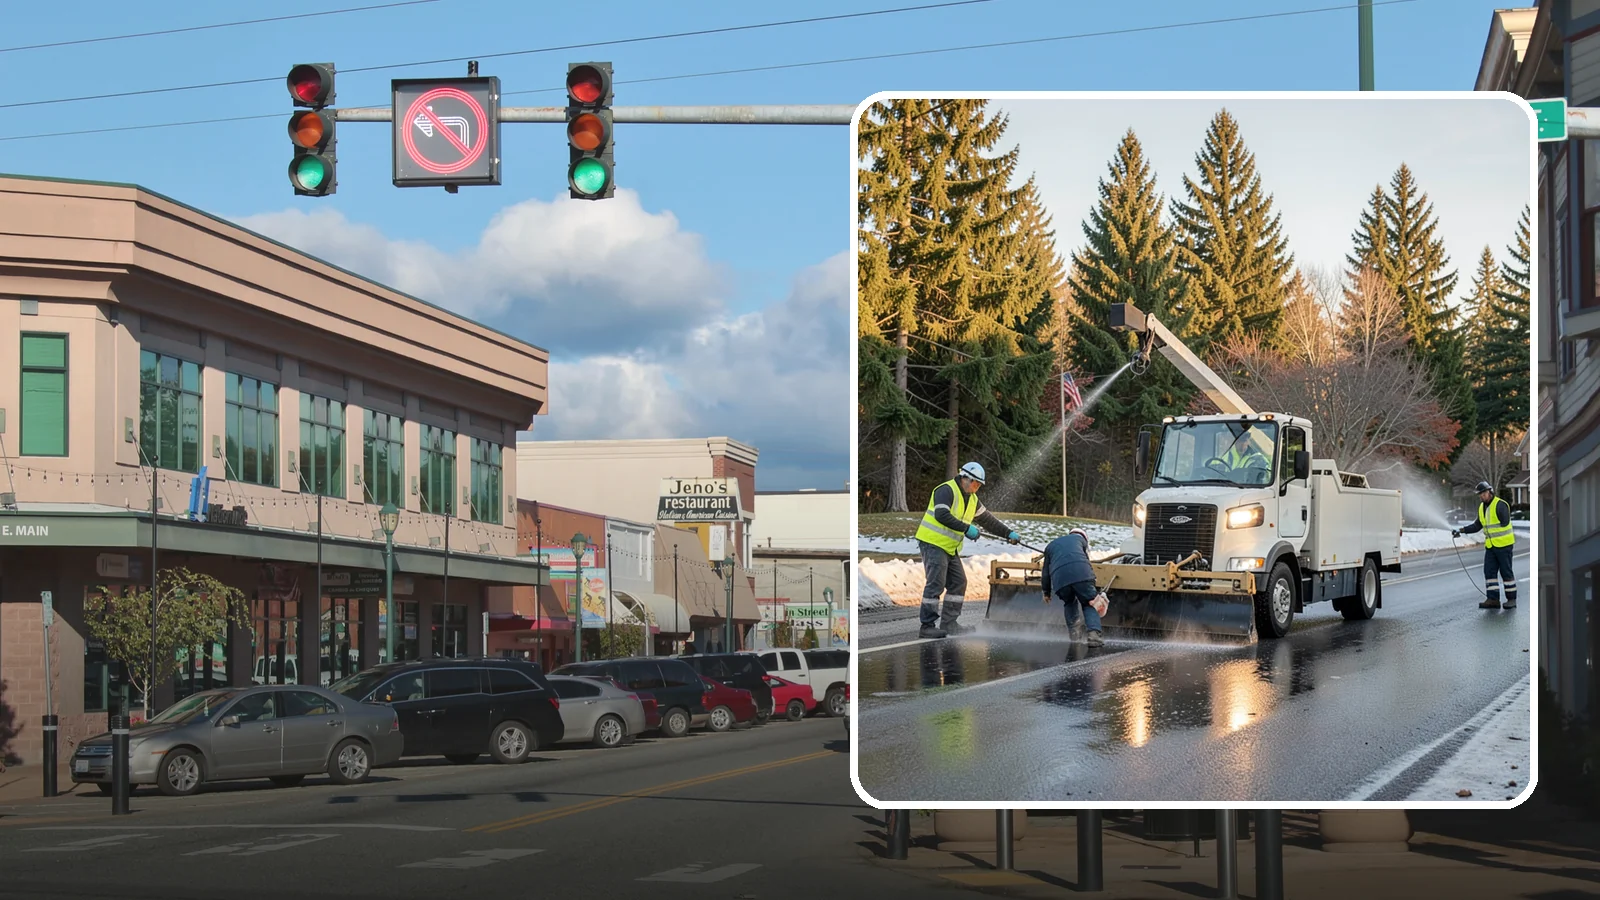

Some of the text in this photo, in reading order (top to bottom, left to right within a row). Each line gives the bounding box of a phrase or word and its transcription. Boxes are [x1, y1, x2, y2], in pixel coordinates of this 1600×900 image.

[669, 480, 727, 494] Jeno's
[665, 497, 731, 509] restaurant
[658, 510, 681, 519] Italian
[686, 510, 714, 519] American
[715, 510, 737, 519] Cuisine
[2, 525, 49, 536] E. MAIN
[797, 608, 828, 616] Street
